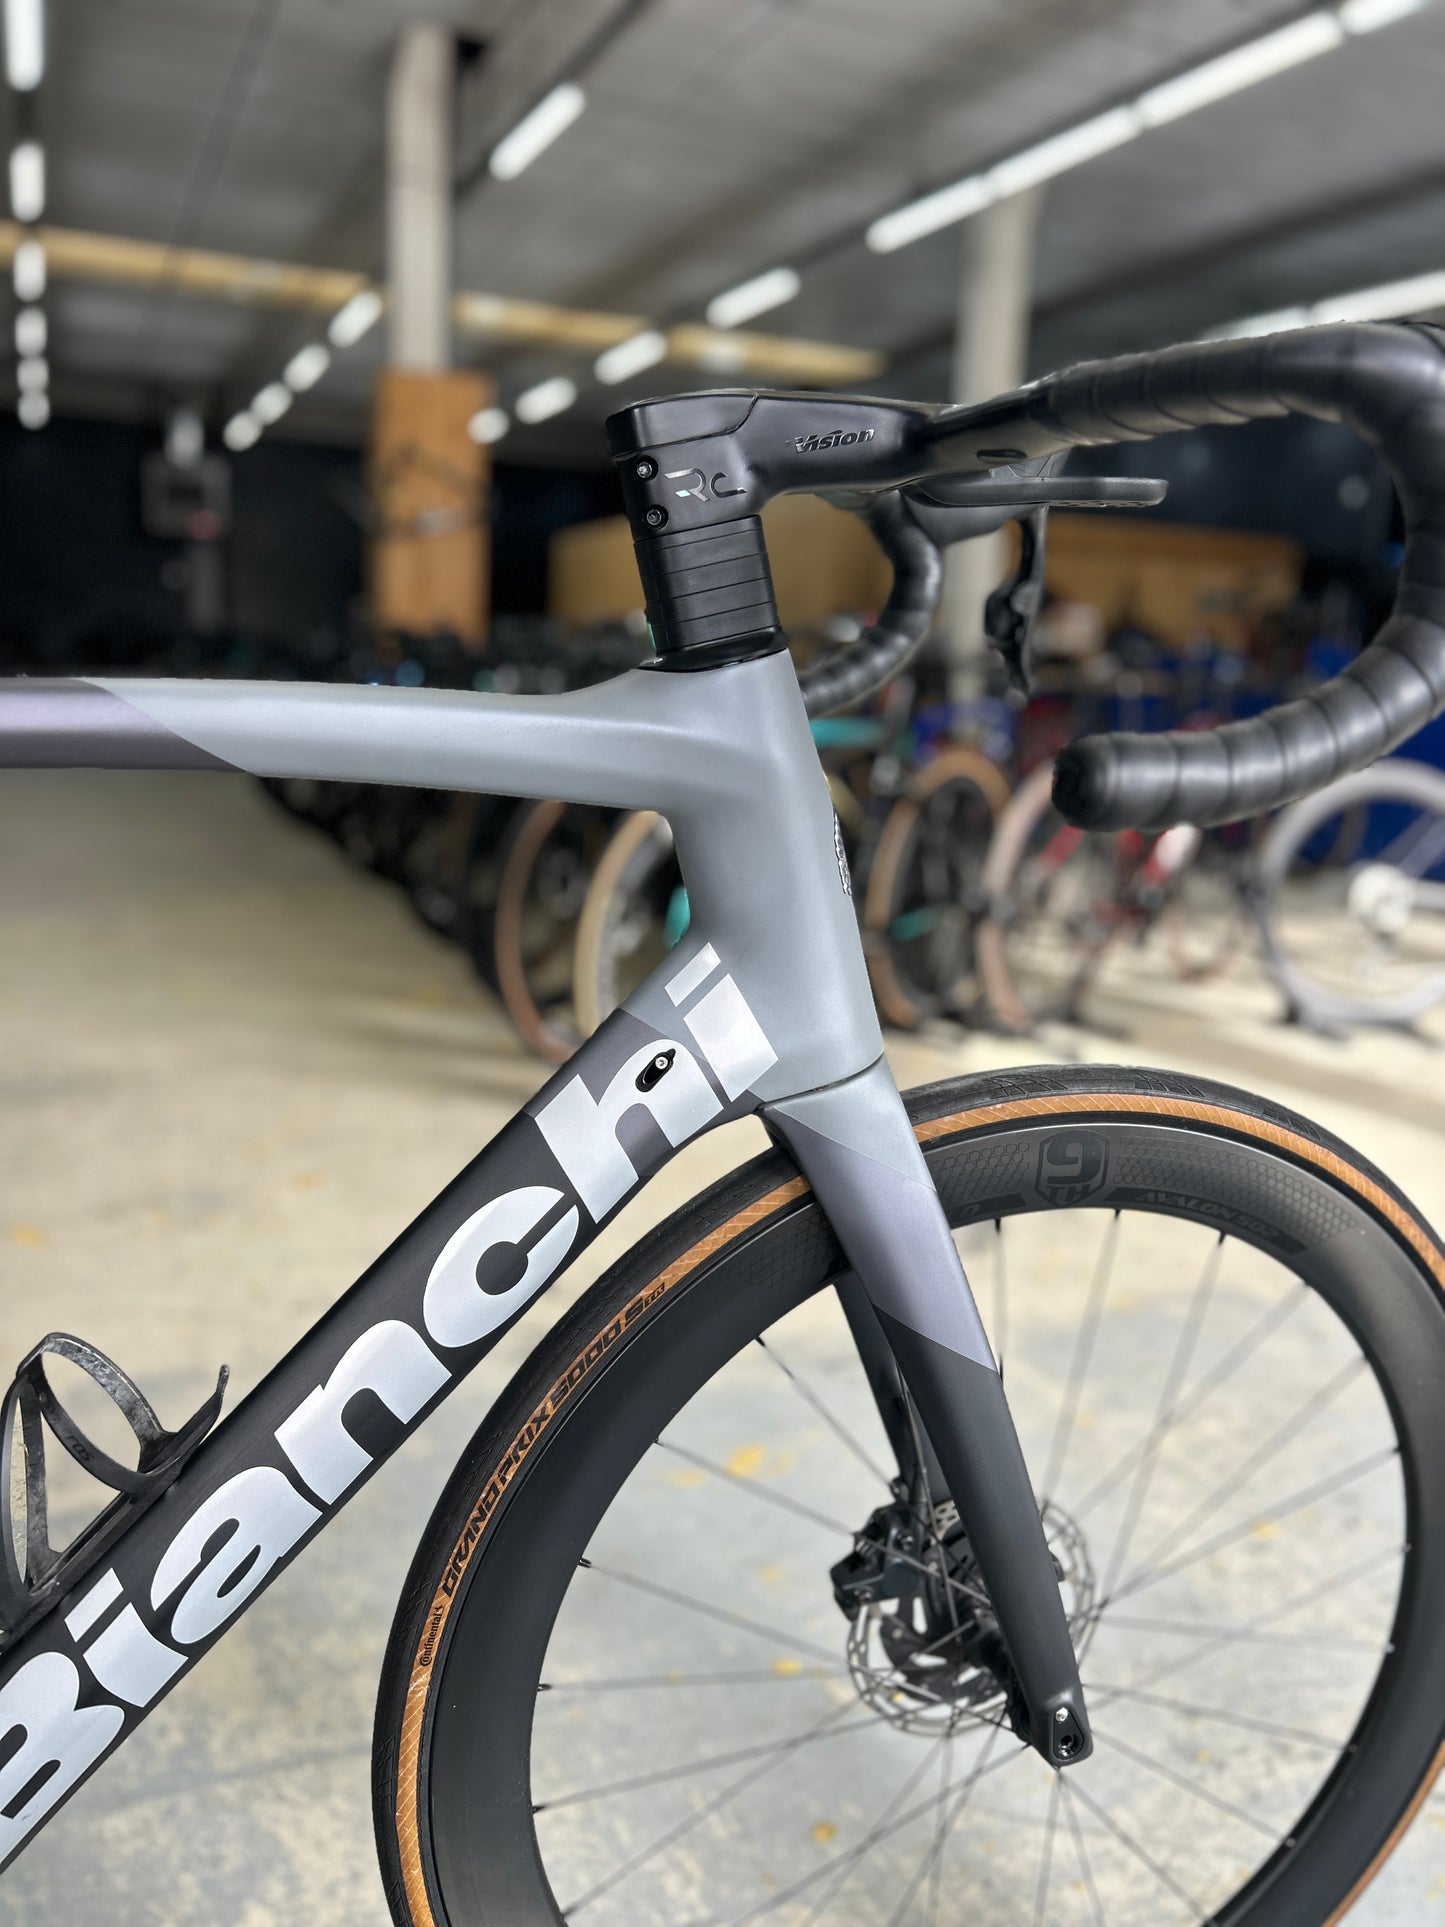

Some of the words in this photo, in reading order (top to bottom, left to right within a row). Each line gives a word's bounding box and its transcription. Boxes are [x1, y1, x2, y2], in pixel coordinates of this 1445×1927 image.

[794, 428, 875, 454] Vision
[664, 467, 747, 501] RC
[1046, 1184, 1091, 1203] TH
[1135, 1190, 1235, 1221] AVALON
[0, 942, 779, 1871] Bianchi
[420, 1611, 444, 1667] Continental
[442, 1481, 499, 1597] GRAND
[498, 1404, 550, 1486] PRIX
[550, 1319, 621, 1410] 5000
